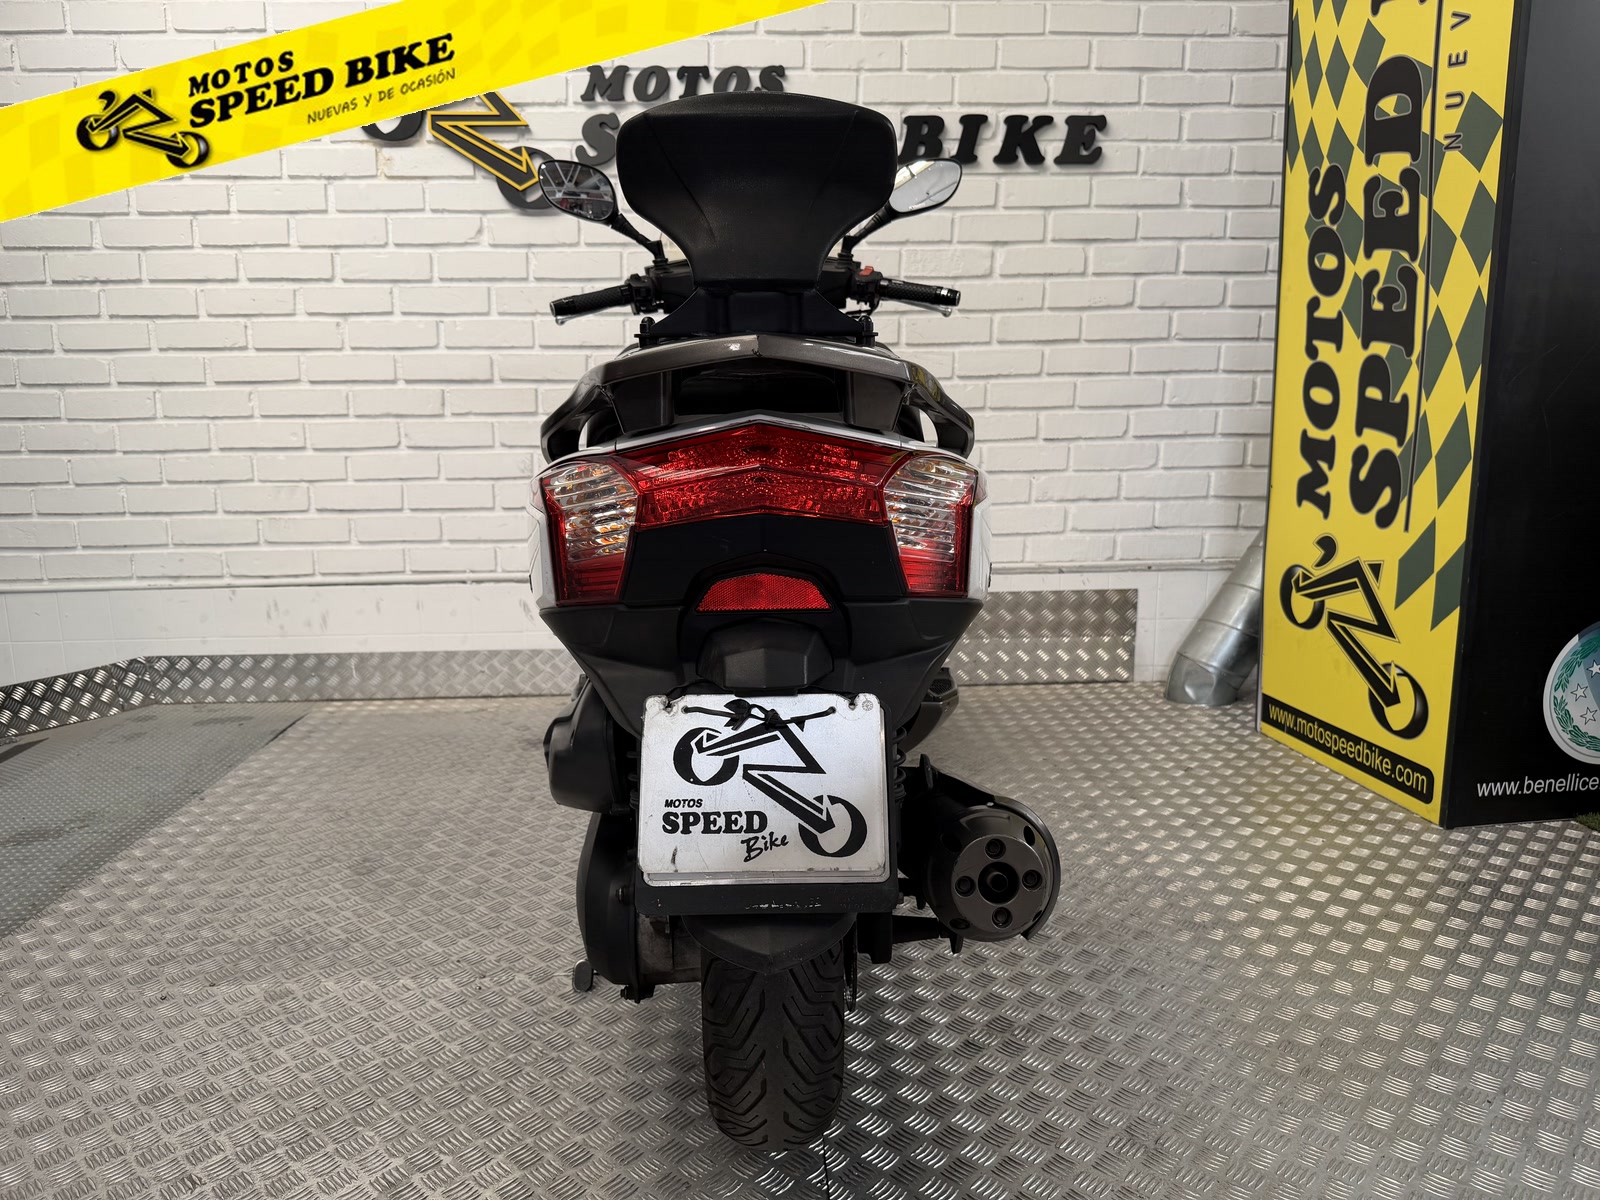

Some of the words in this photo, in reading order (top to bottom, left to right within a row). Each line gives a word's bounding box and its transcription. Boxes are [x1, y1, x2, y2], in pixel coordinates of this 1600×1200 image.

[580, 65, 785, 101] MOTOS
[1443, 11, 1471, 152] NUEV
[899, 114, 1107, 166] BIKE
[1349, 54, 1423, 530] SPEED
[1296, 163, 1346, 521] MOTOS
[1269, 703, 1427, 794] www.motospeedbike.com
[662, 810, 768, 834] SPEED
[664, 798, 703, 808] MOTOS
[740, 832, 789, 862] Bike
